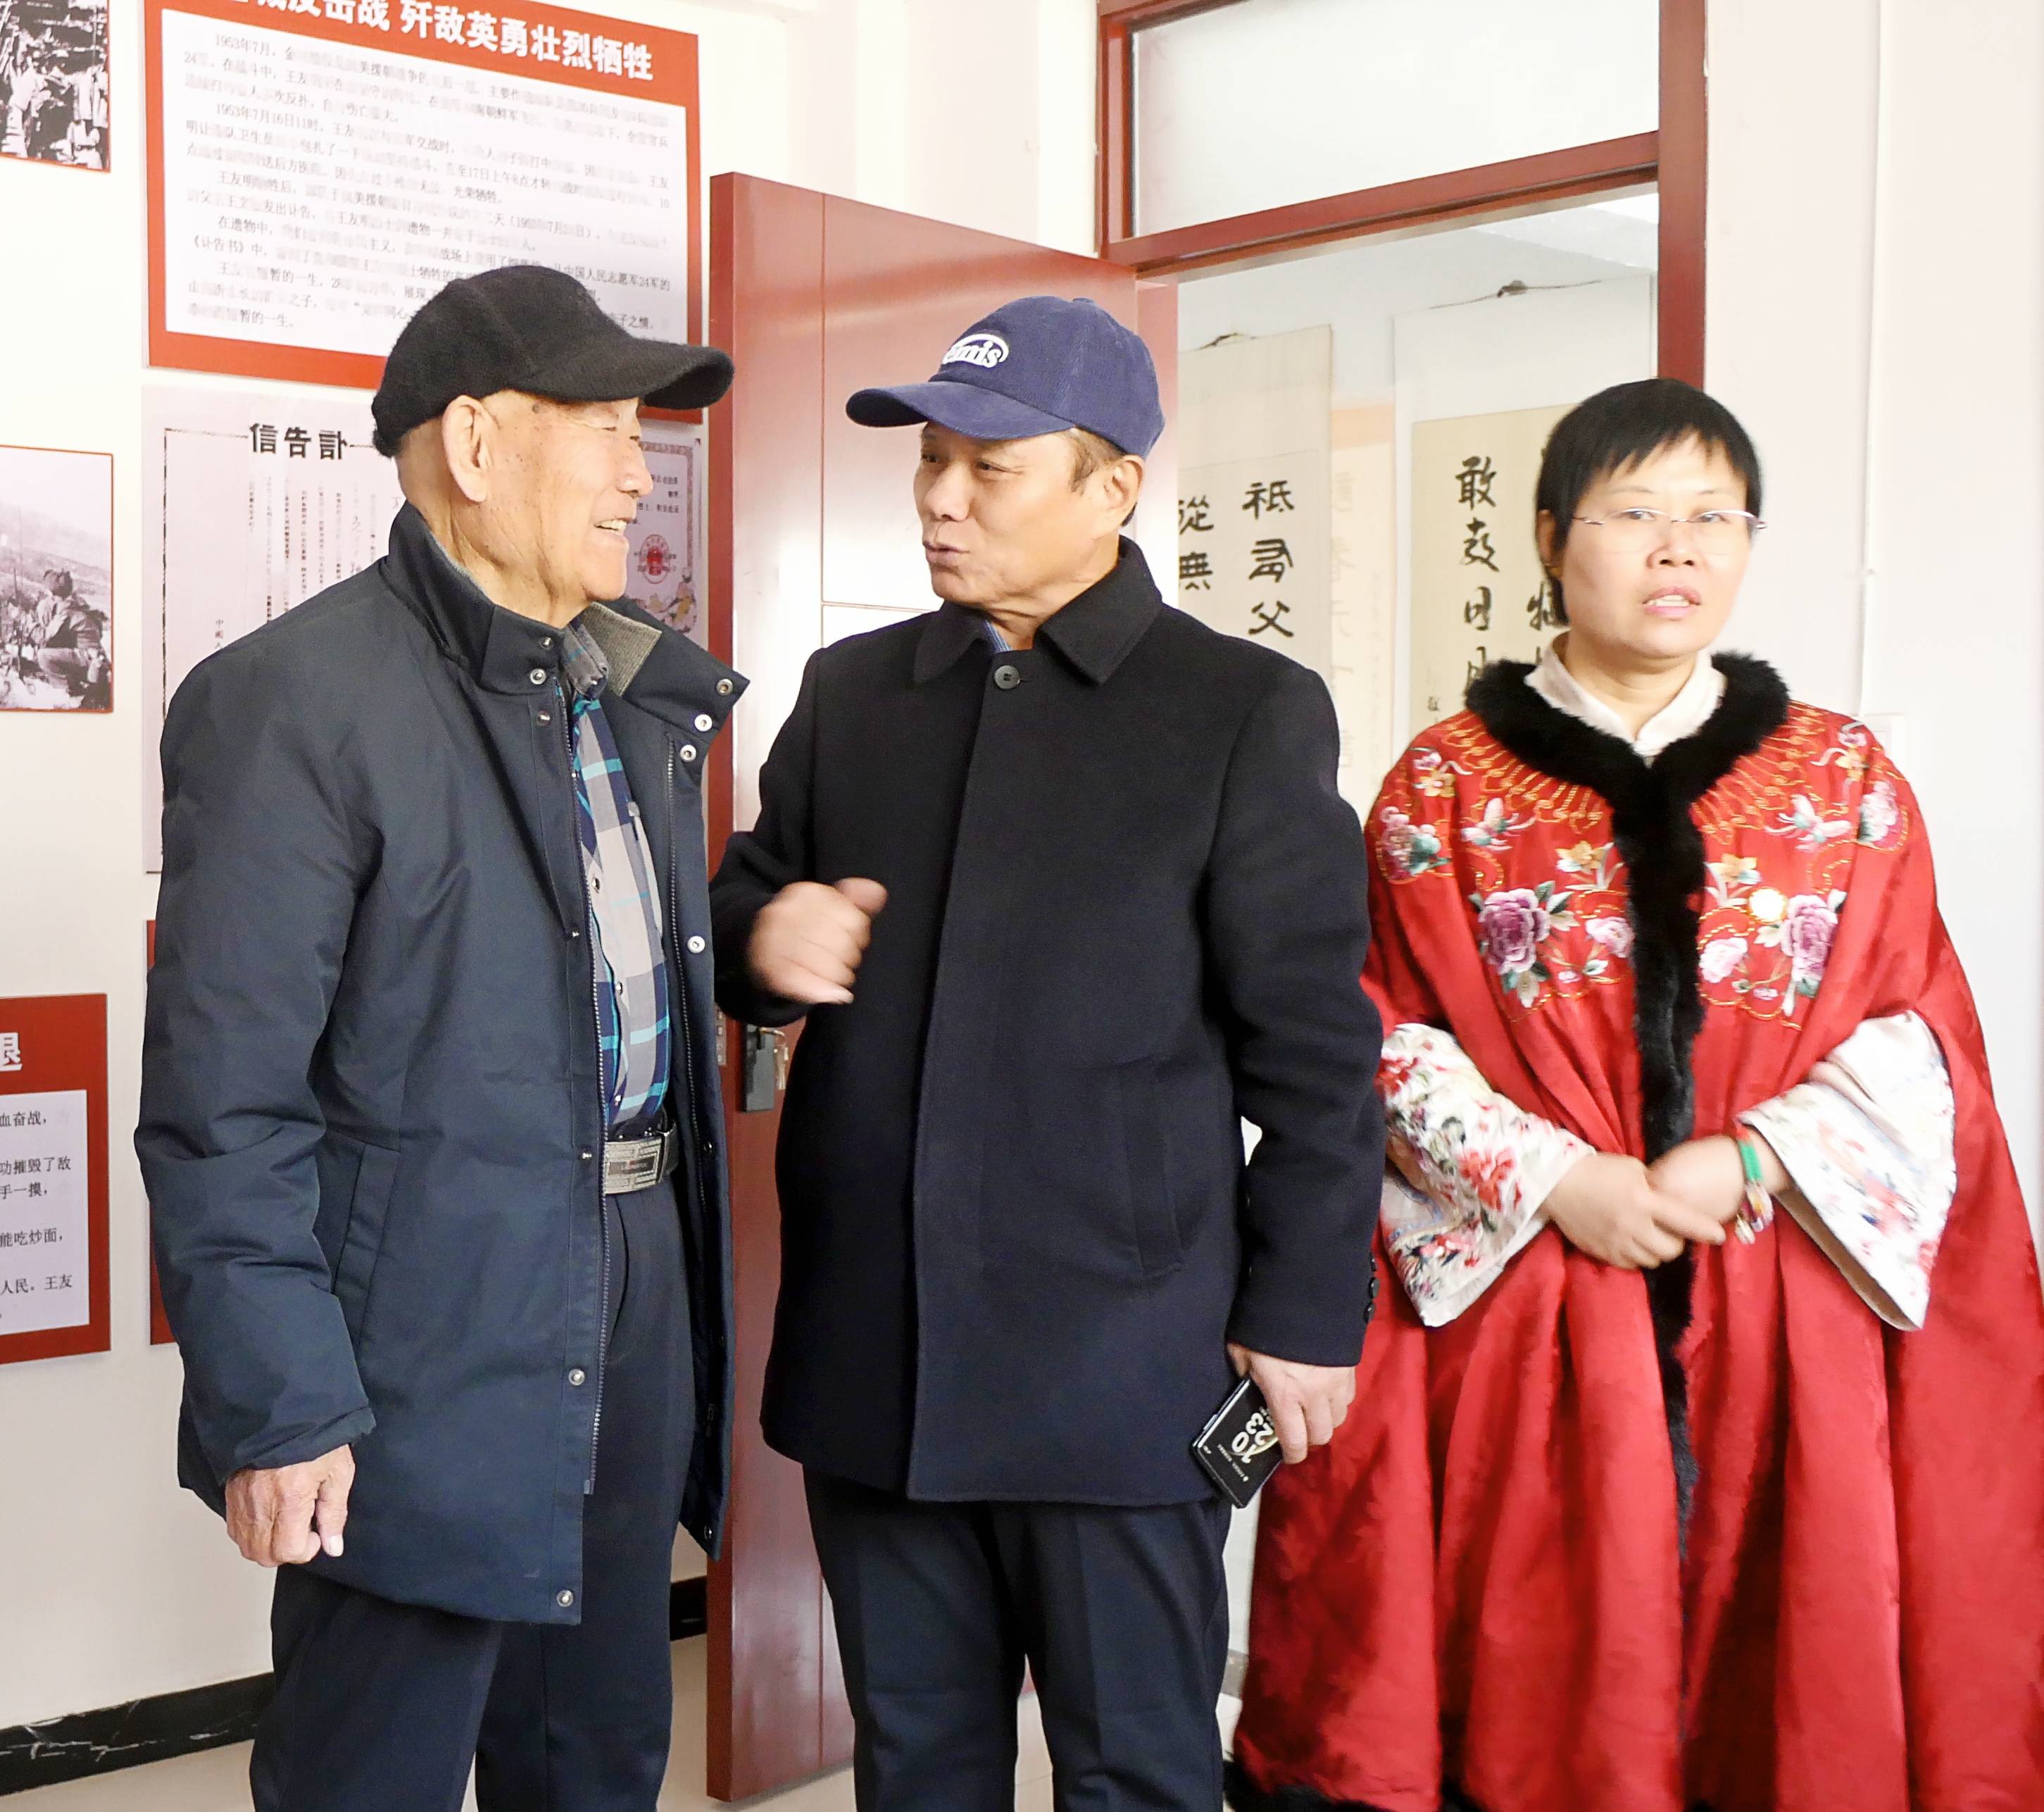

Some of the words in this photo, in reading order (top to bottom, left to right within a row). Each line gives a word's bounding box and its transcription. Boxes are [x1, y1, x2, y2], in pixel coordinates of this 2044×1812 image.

[401, 0, 653, 81] 歼敌英勇壮烈牺牲
